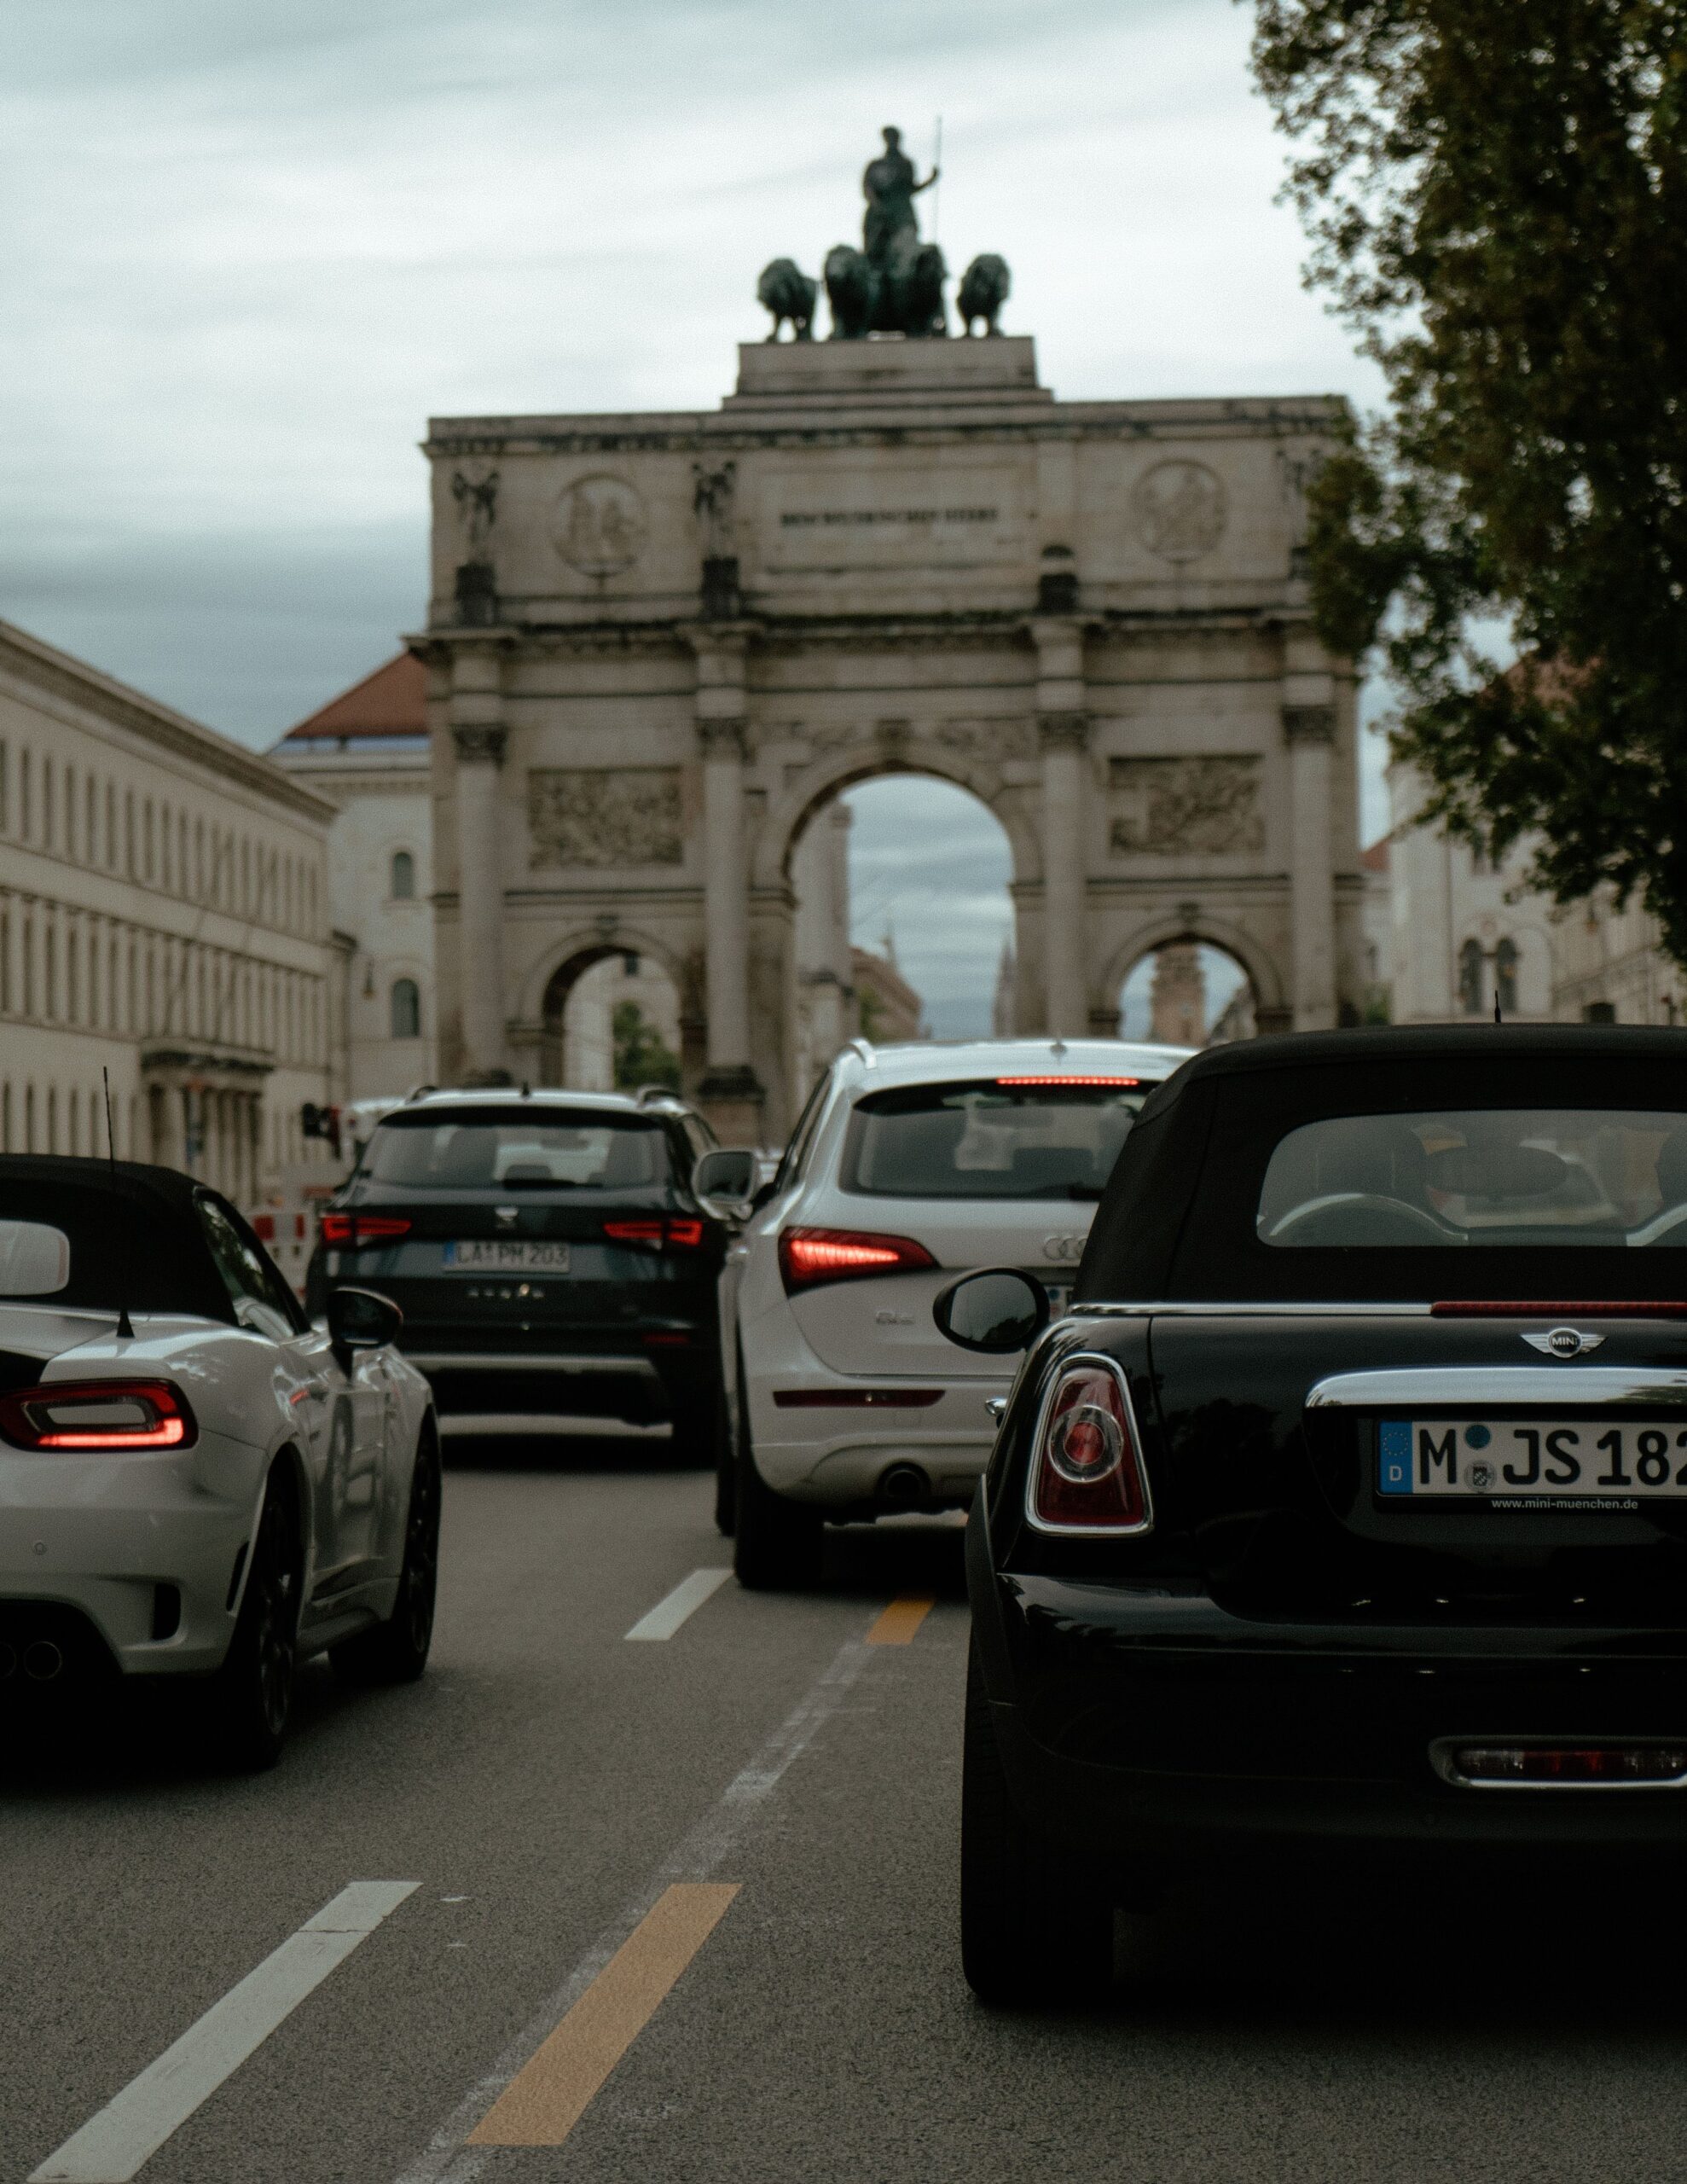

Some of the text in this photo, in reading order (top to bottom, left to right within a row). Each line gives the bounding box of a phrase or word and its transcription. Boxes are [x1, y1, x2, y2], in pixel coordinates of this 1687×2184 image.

[1551, 1335, 1579, 1346] MINI
[1418, 1428, 1458, 1485] M
[1502, 1428, 1582, 1486] JS
[1388, 1464, 1404, 1483] D
[1491, 1498, 1638, 1509] www.mini-muenchen.de
